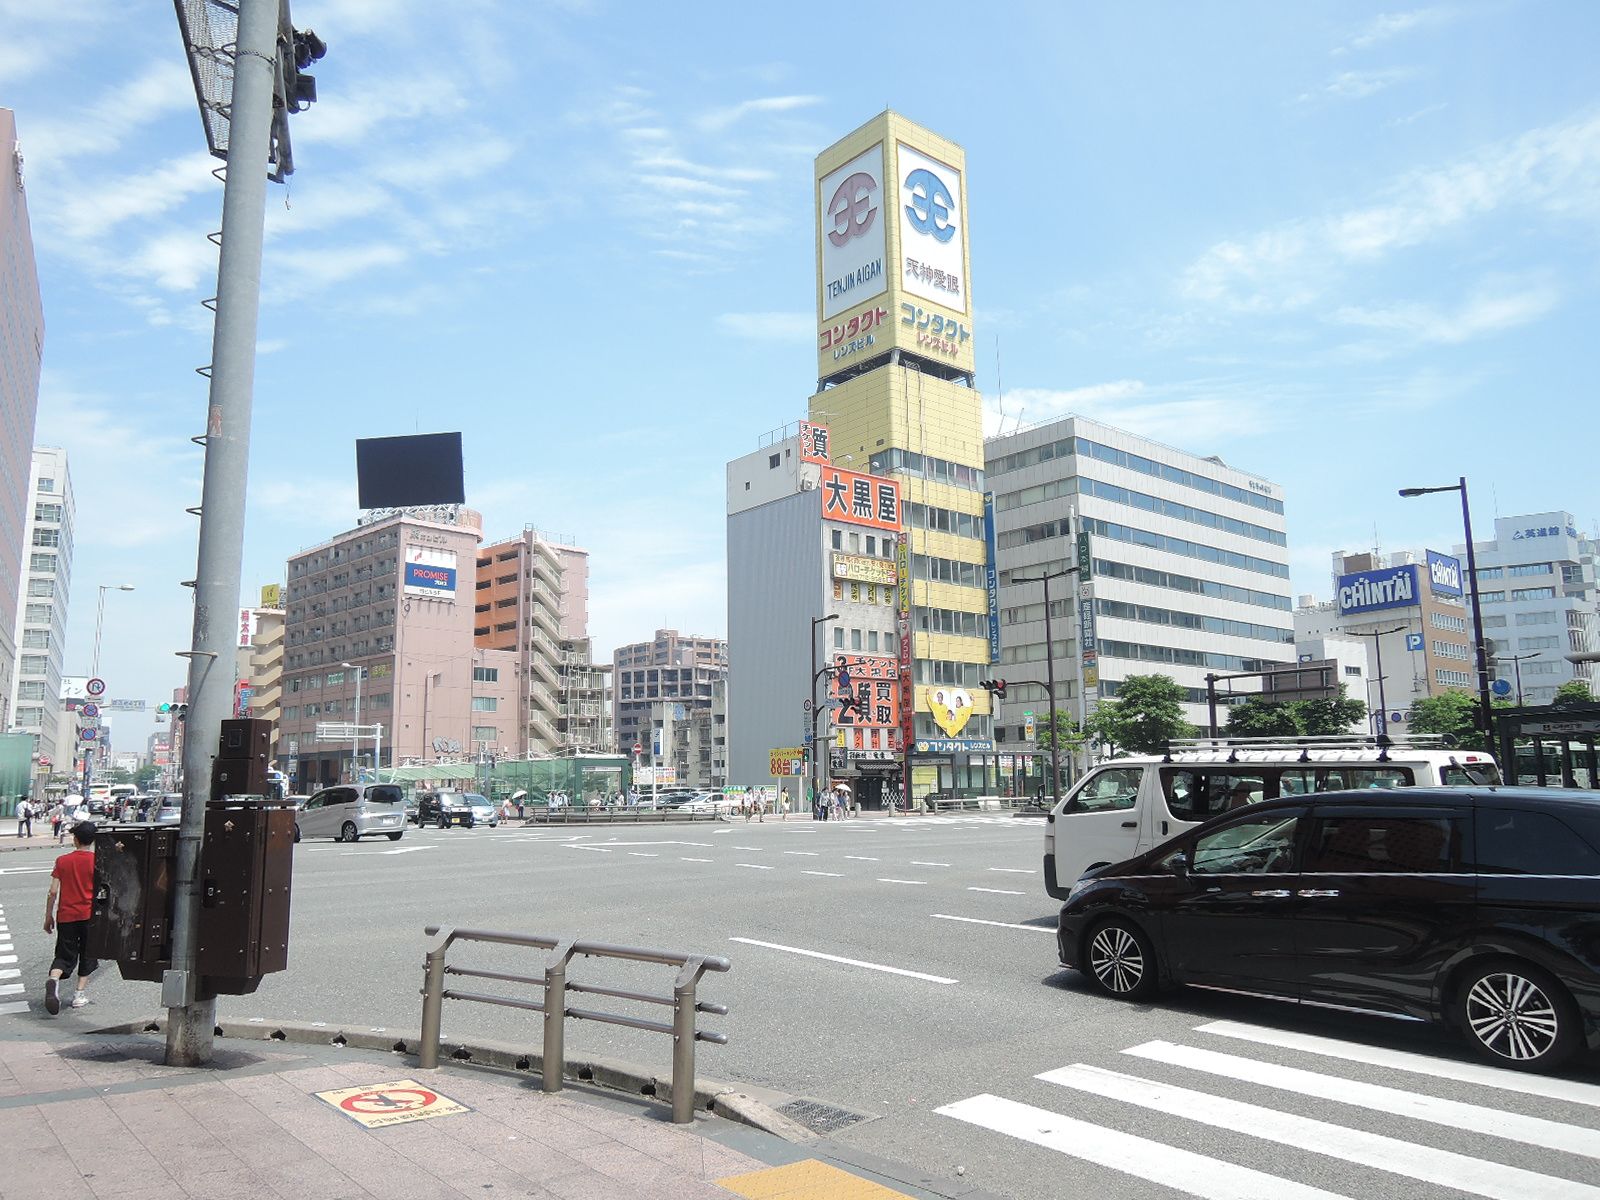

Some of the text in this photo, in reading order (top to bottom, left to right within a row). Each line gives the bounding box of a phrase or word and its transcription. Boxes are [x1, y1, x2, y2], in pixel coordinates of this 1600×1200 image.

[827, 258, 882, 300] TENJIN AIGAN
[905, 257, 960, 295] 天神愛眼
[819, 306, 888, 350] コンタクト
[901, 302, 971, 344] コンタクト
[833, 334, 875, 359] レンズビル
[916, 331, 959, 357] レンズビル
[802, 424, 811, 457] チケット
[812, 427, 828, 460] 質
[824, 473, 898, 523] 大黒屋
[413, 568, 449, 581] PROMISE
[1340, 571, 1412, 609] CHINTAI
[1431, 559, 1460, 589] CHINTAI
[988, 570, 997, 616] コンタクト
[1409, 635, 1421, 649] P
[856, 656, 895, 668] チケット
[857, 667, 896, 678] 大黒屋
[858, 682, 872, 723] 質
[876, 681, 892, 724] 買取
[930, 741, 969, 752] コンタクト
[771, 758, 801, 775] 88台 P
